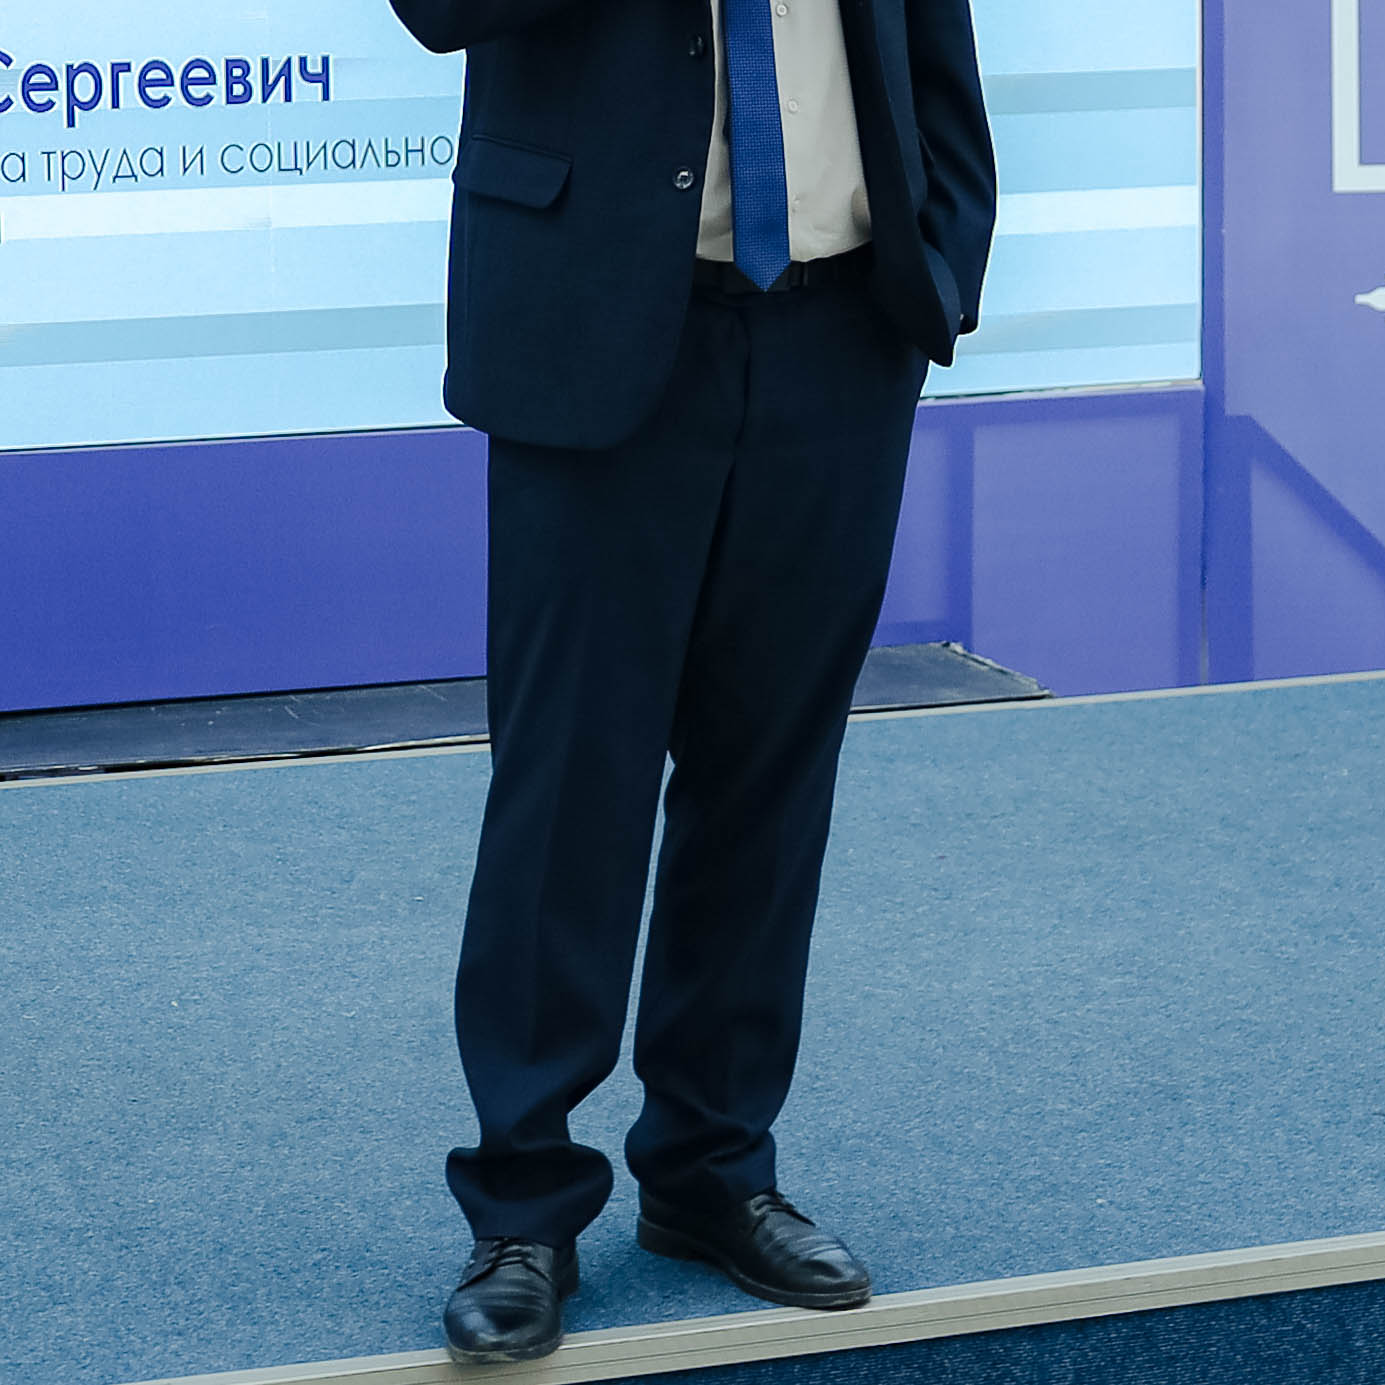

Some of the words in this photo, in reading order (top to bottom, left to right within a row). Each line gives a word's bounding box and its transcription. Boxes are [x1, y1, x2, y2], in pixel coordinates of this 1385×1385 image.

[40, 146, 165, 192] труда
[181, 144, 205, 178] и
[220, 135, 454, 177] социально
